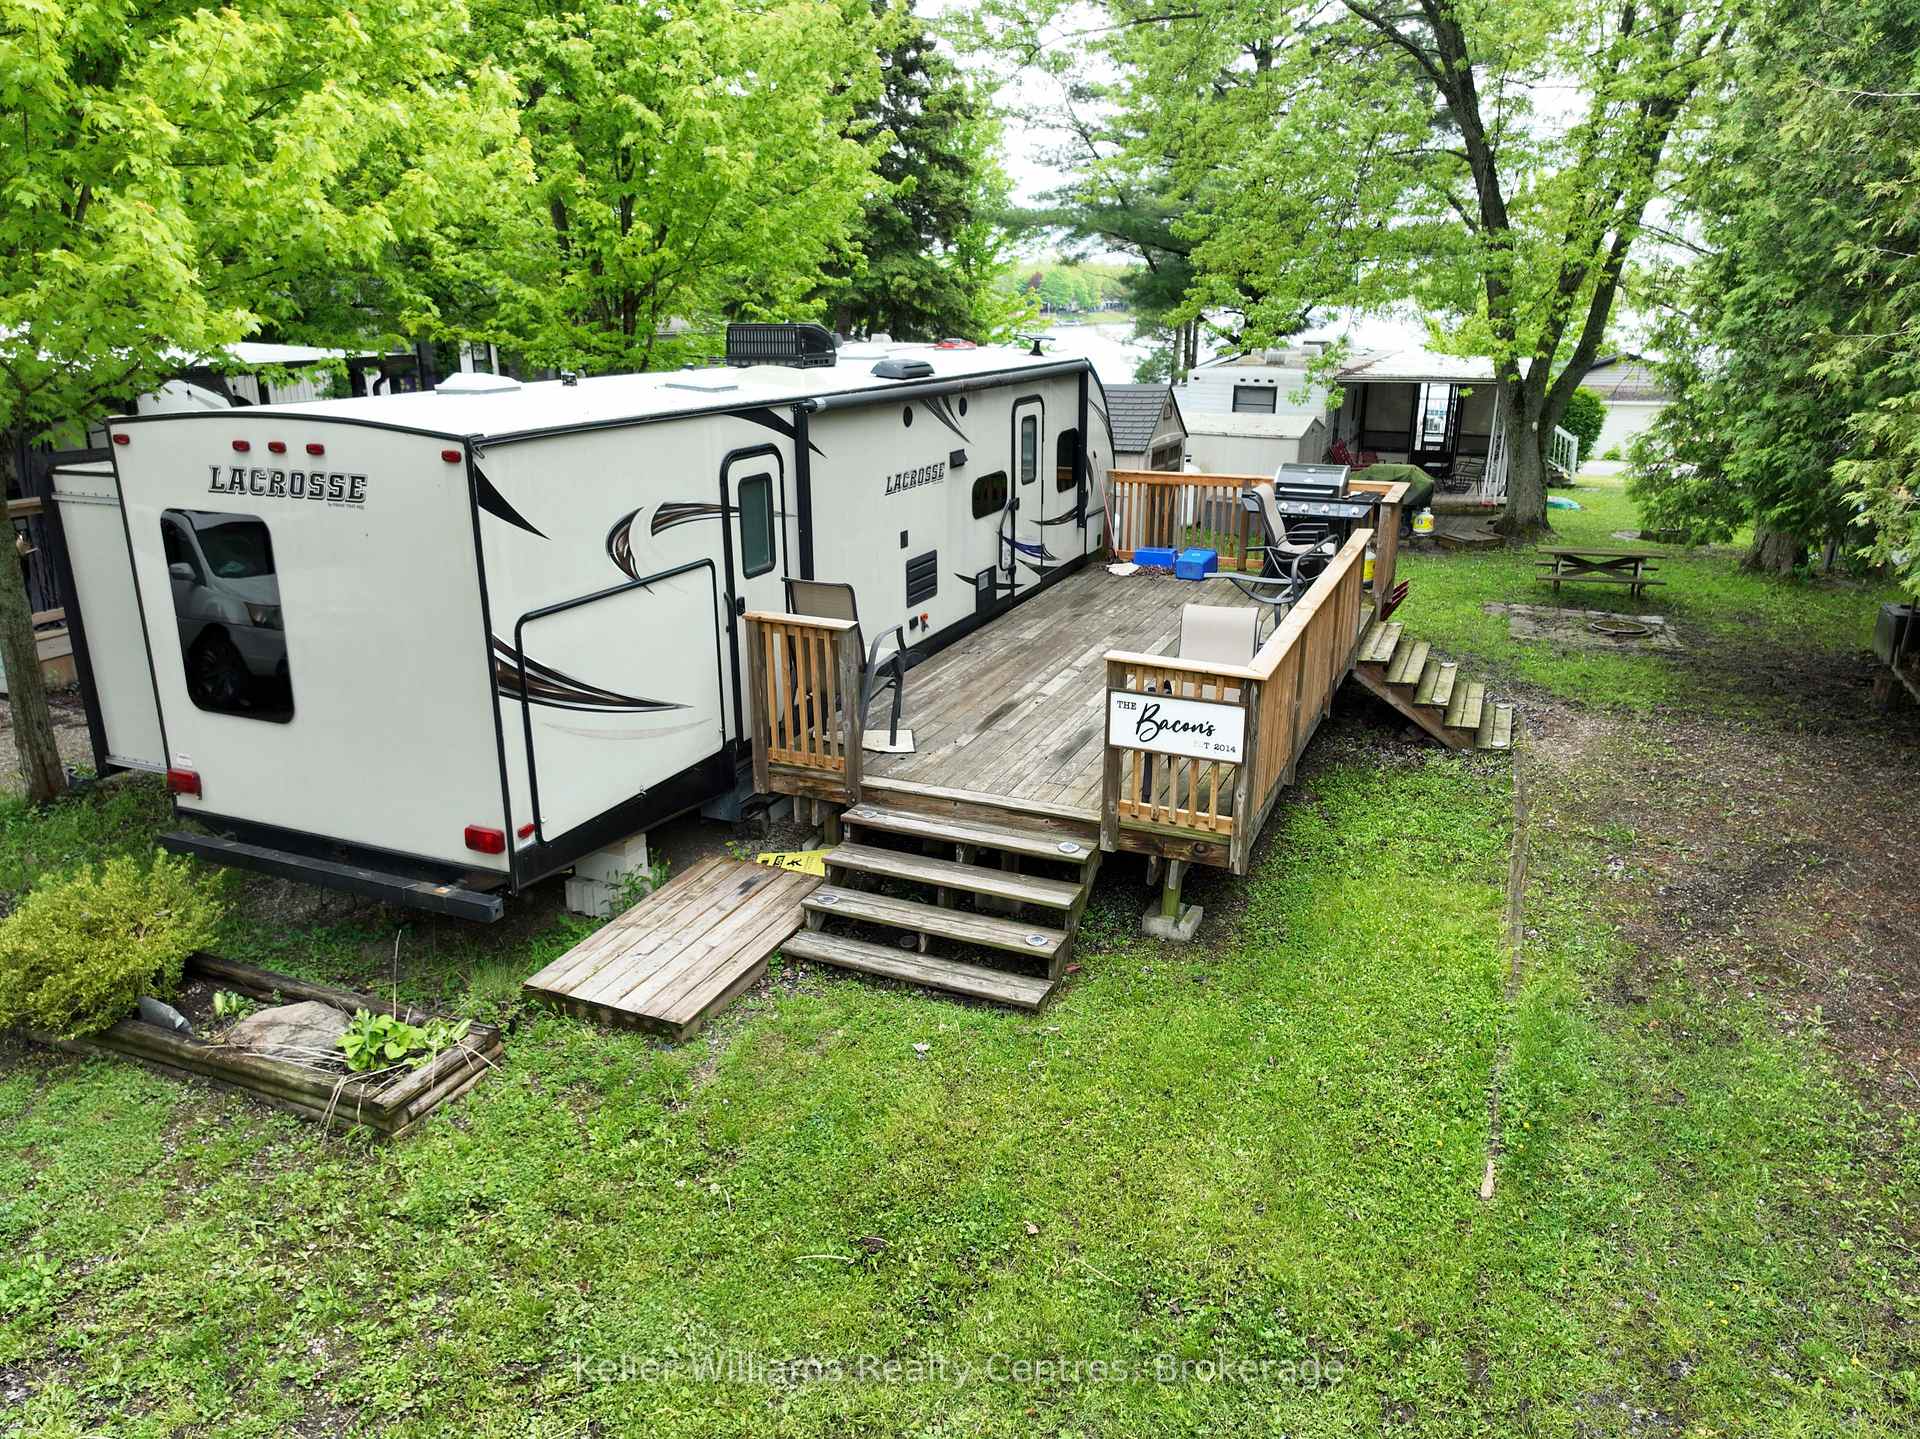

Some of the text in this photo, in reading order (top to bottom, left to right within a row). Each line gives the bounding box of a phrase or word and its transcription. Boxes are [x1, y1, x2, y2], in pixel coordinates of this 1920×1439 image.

[208, 465, 368, 503] LACROSSE
[885, 462, 945, 496] LACROSSE
[1116, 700, 1216, 742] THE Bacon's
[1213, 743, 1236, 753] 2014
